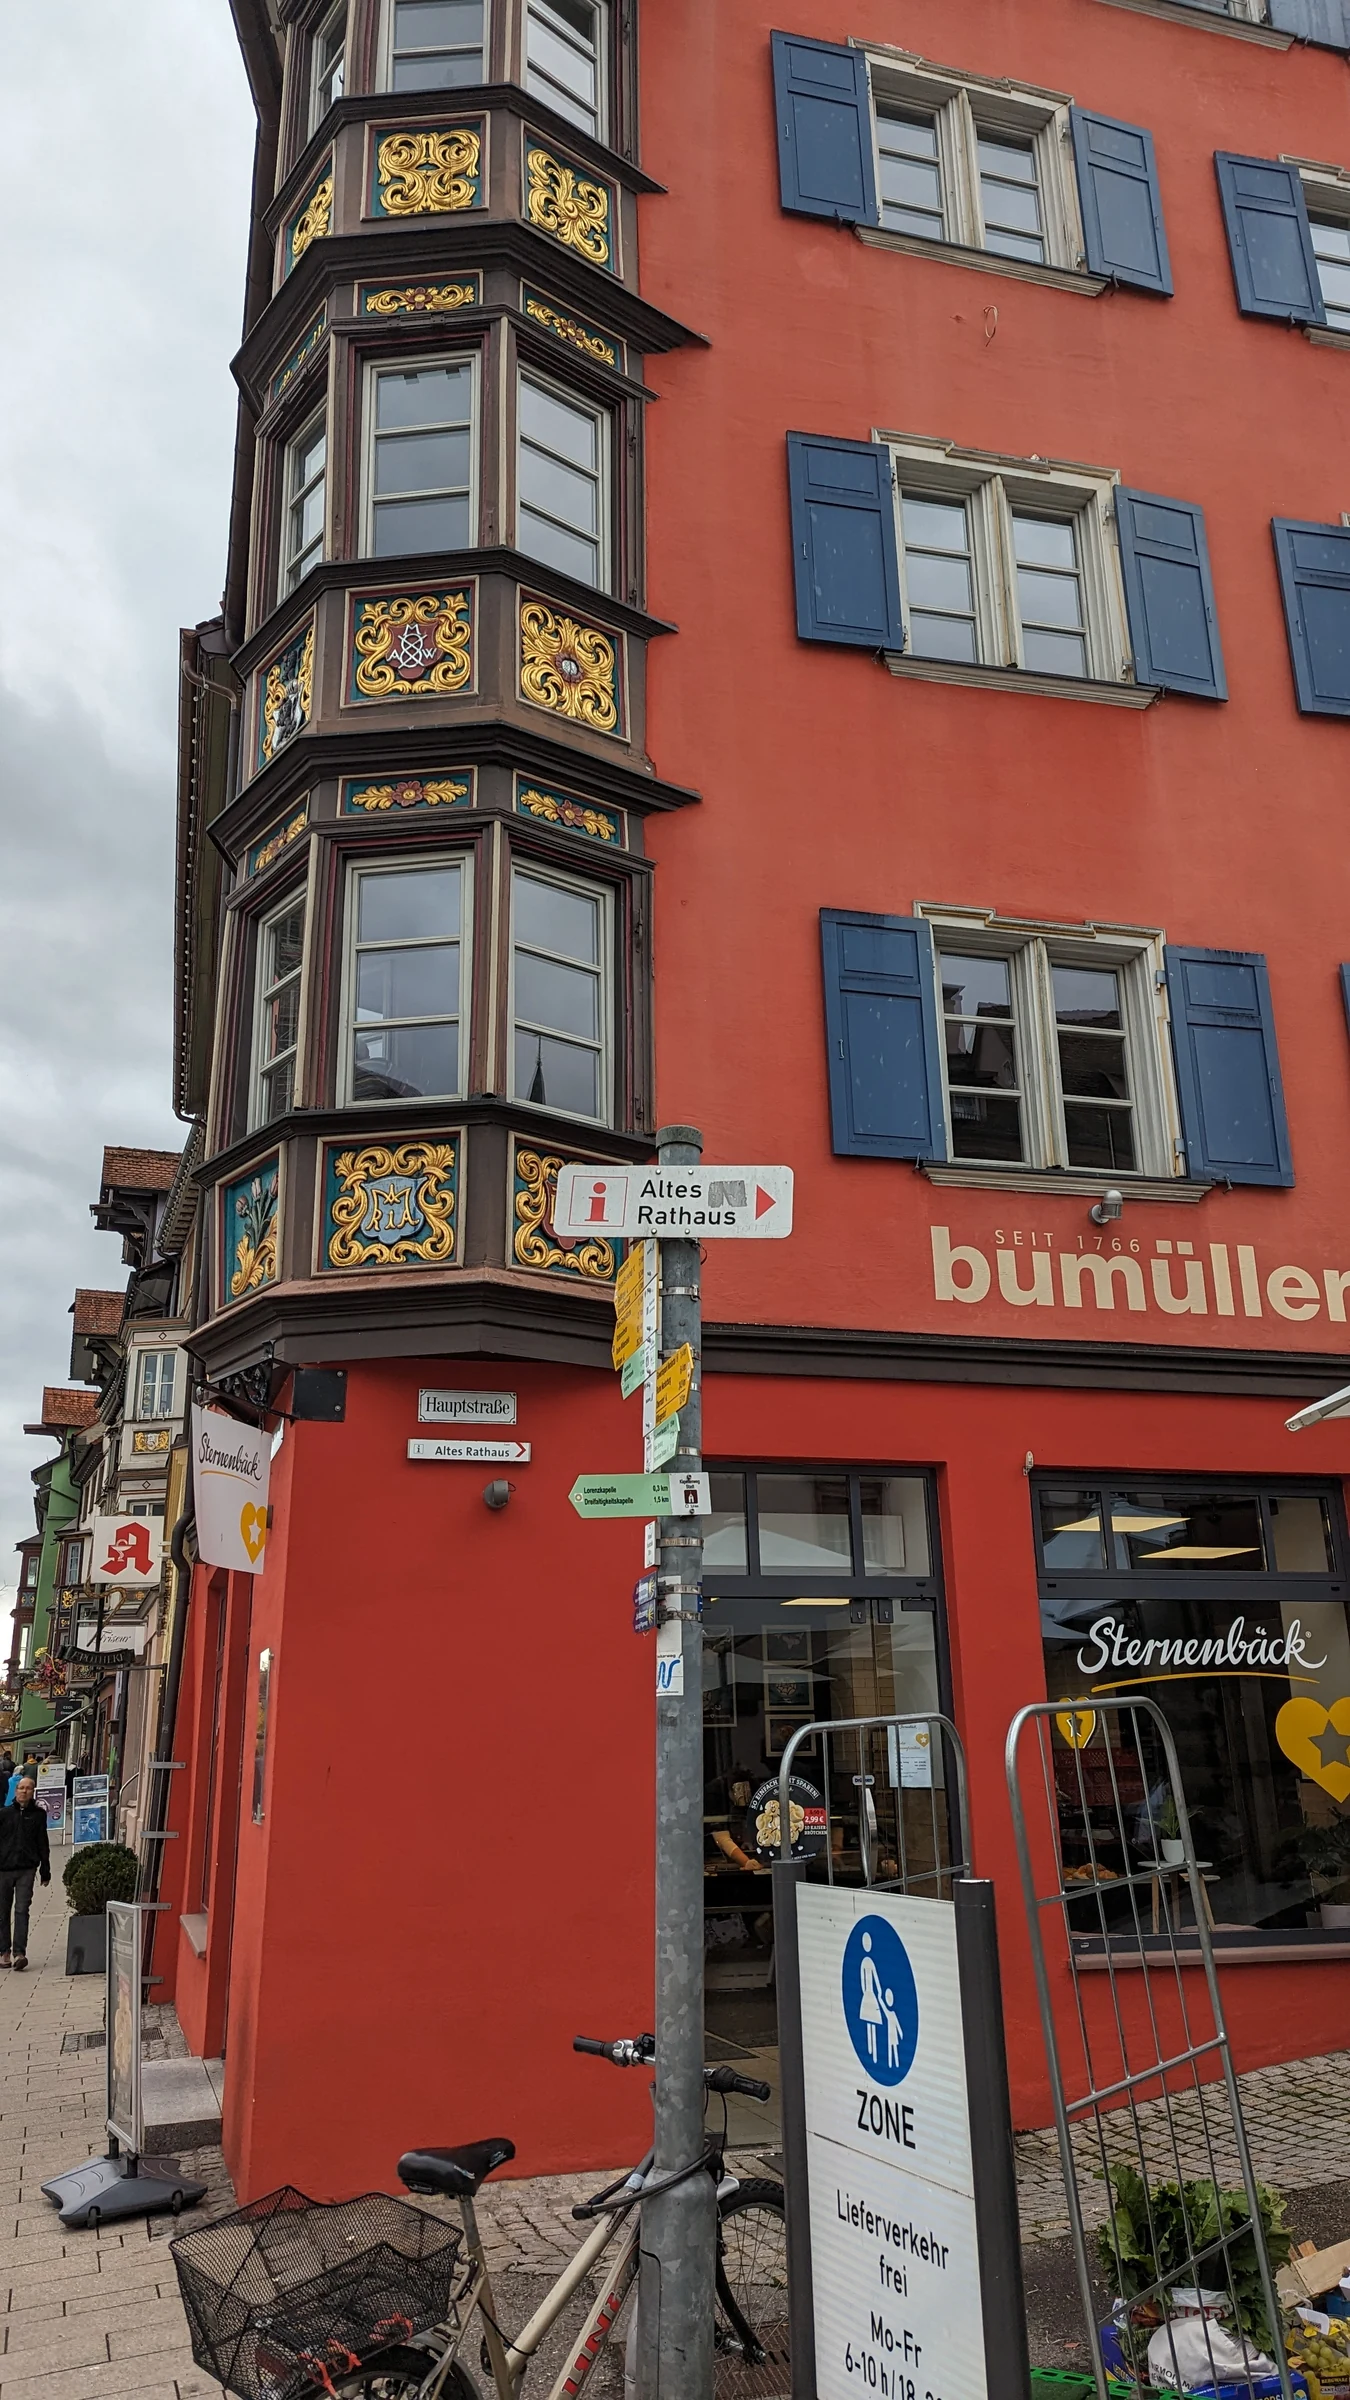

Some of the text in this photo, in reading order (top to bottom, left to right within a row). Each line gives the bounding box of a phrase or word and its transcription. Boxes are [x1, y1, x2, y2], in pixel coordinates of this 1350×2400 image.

[640, 1180, 702, 1199] Altes
[638, 1206, 736, 1226] Rathaus
[994, 1229, 1140, 1253] SEIT 1766
[425, 1396, 510, 1417] Hauptstraße
[199, 1432, 262, 1481] Sternenbäck
[434, 1445, 463, 1456] Altes
[464, 1446, 510, 1457] Rathaus
[583, 1486, 617, 1494] Lorenzkapelle
[584, 1497, 634, 1506] Dreifaltigkeitskapelle
[1077, 1616, 1328, 1674] Sternenbäck
[755, 1780, 779, 1800] EINFACH
[856, 2089, 917, 2150] ZONE
[836, 2188, 950, 2271] Lieferverkehr
[879, 2254, 909, 2298] frei
[870, 2310, 923, 2369] Mo-Fr
[845, 2342, 877, 2388] 6-10
